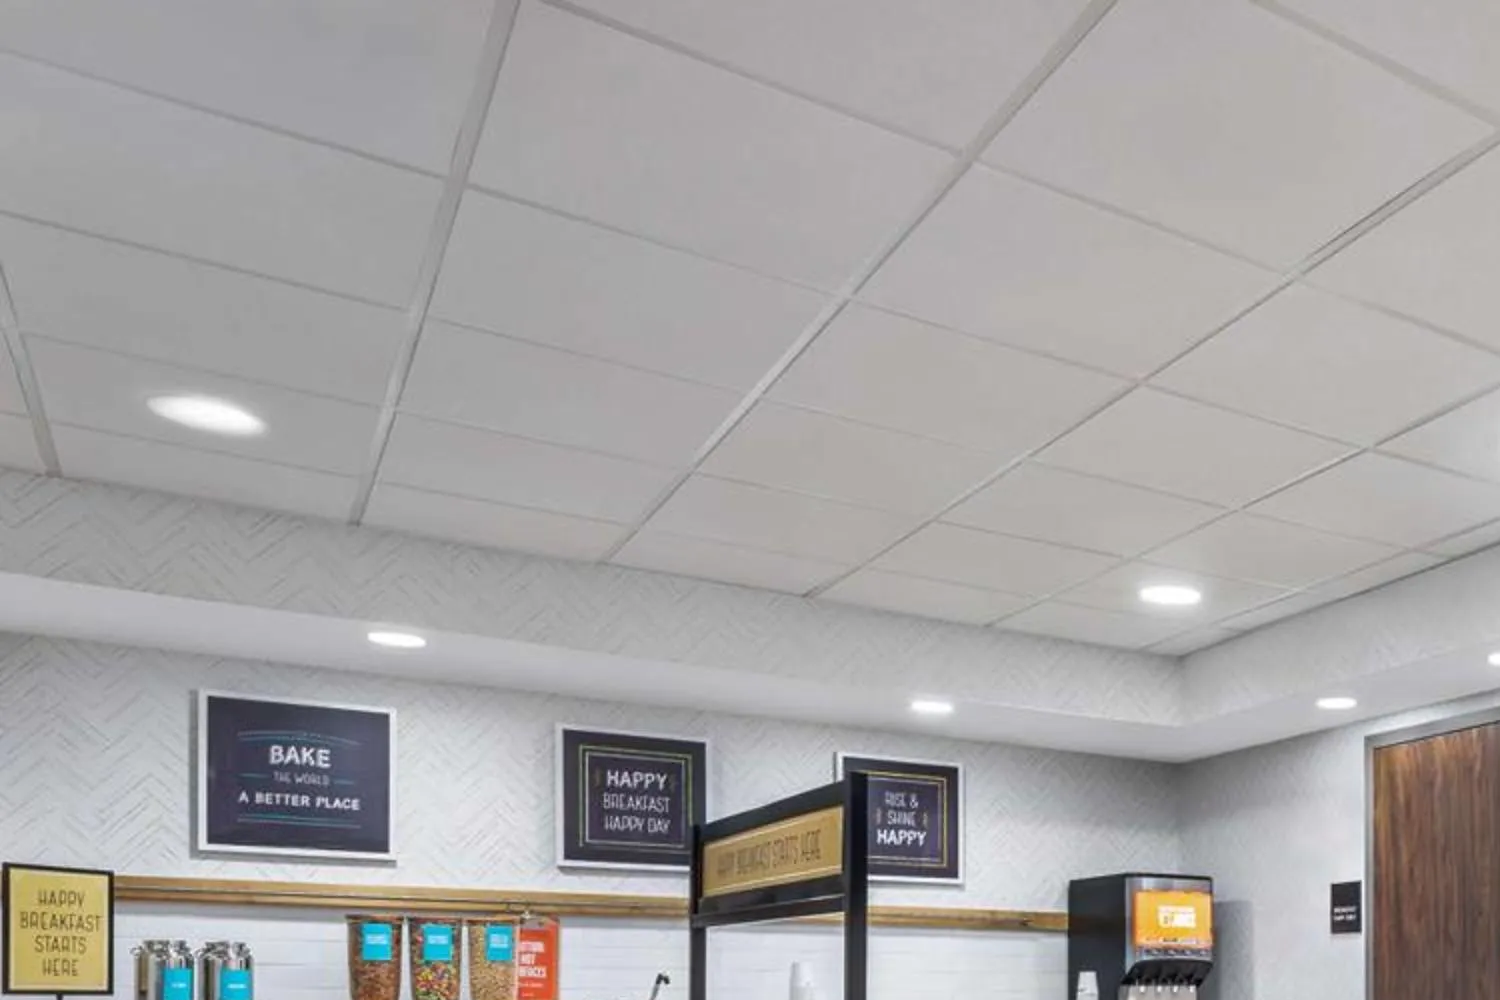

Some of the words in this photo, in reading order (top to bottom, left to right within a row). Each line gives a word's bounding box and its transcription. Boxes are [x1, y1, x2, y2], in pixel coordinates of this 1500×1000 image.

[269, 743, 332, 769] BAKE
[606, 769, 668, 791] HAPPY
[238, 790, 250, 804] A
[255, 791, 311, 808] BETTER
[315, 795, 361, 811] PLACE
[603, 791, 671, 814] BREAKFAST
[604, 814, 645, 832] HAPPY
[647, 817, 671, 835] DAY
[876, 828, 927, 847] HAPPY
[38, 889, 85, 908] HAPPY
[20, 911, 103, 933] BREAKFAST
[34, 934, 88, 955] STARTS
[42, 957, 79, 977] HERE
